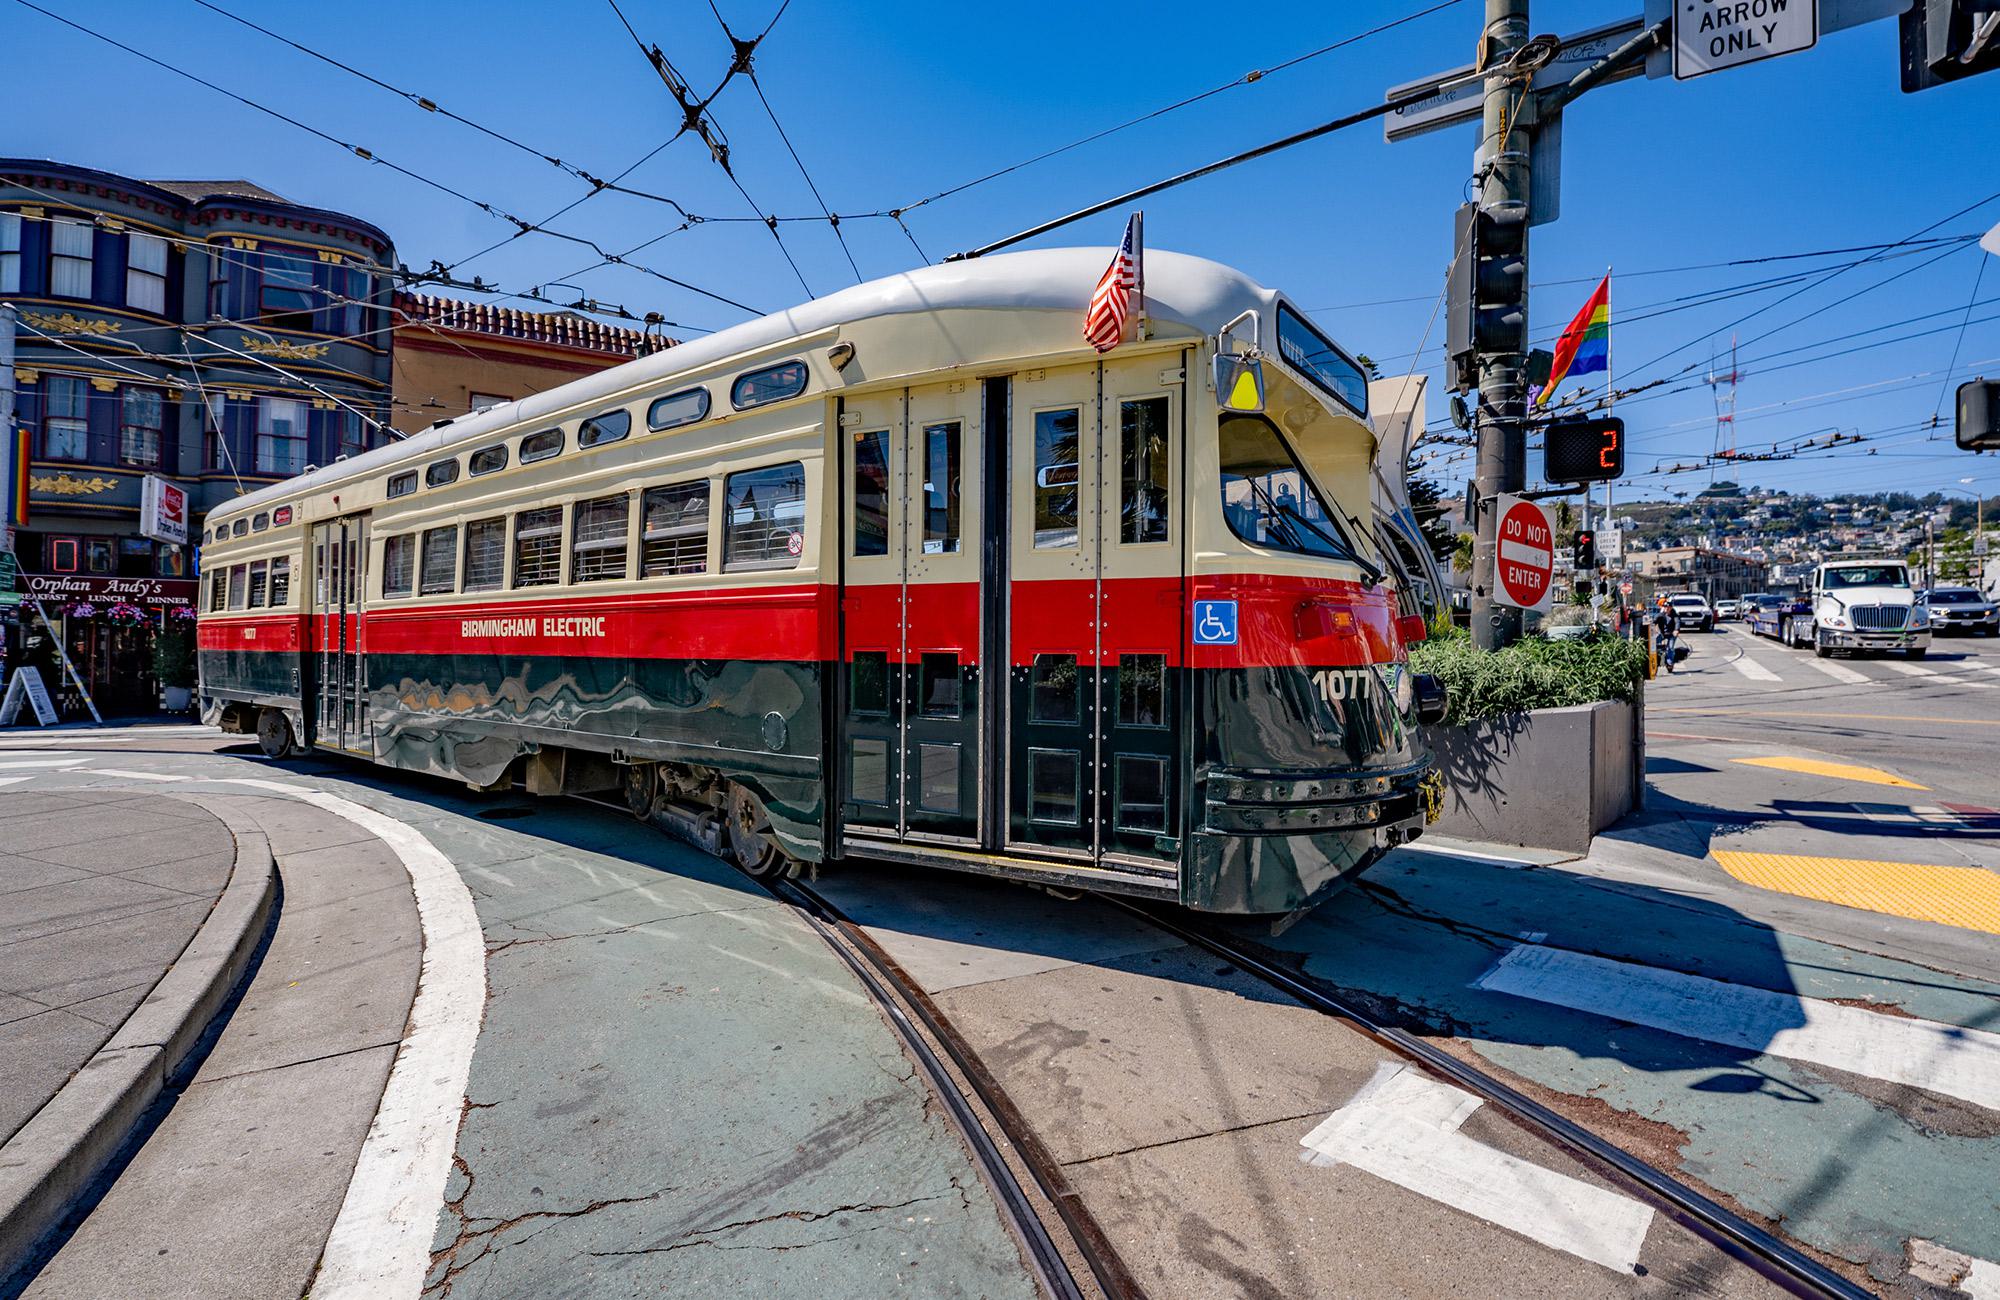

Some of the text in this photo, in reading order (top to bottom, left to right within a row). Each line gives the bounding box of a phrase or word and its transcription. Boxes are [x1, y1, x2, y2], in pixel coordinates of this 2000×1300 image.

[1699, 0, 1788, 33] ARROW
[1710, 22, 1777, 57] ONLY
[1600, 430, 1616, 467] 2
[1507, 518, 1547, 544] DO NOT
[31, 577, 162, 597] Orphan Andy's
[1509, 566, 1540, 589] ENTER
[18, 593, 68, 601] REAKFAST
[88, 594, 126, 603] LUNCH
[146, 596, 189, 604] DINNER
[461, 616, 606, 638] BIRMINGHAM ELECTRIC
[1312, 669, 1370, 701] 1077
